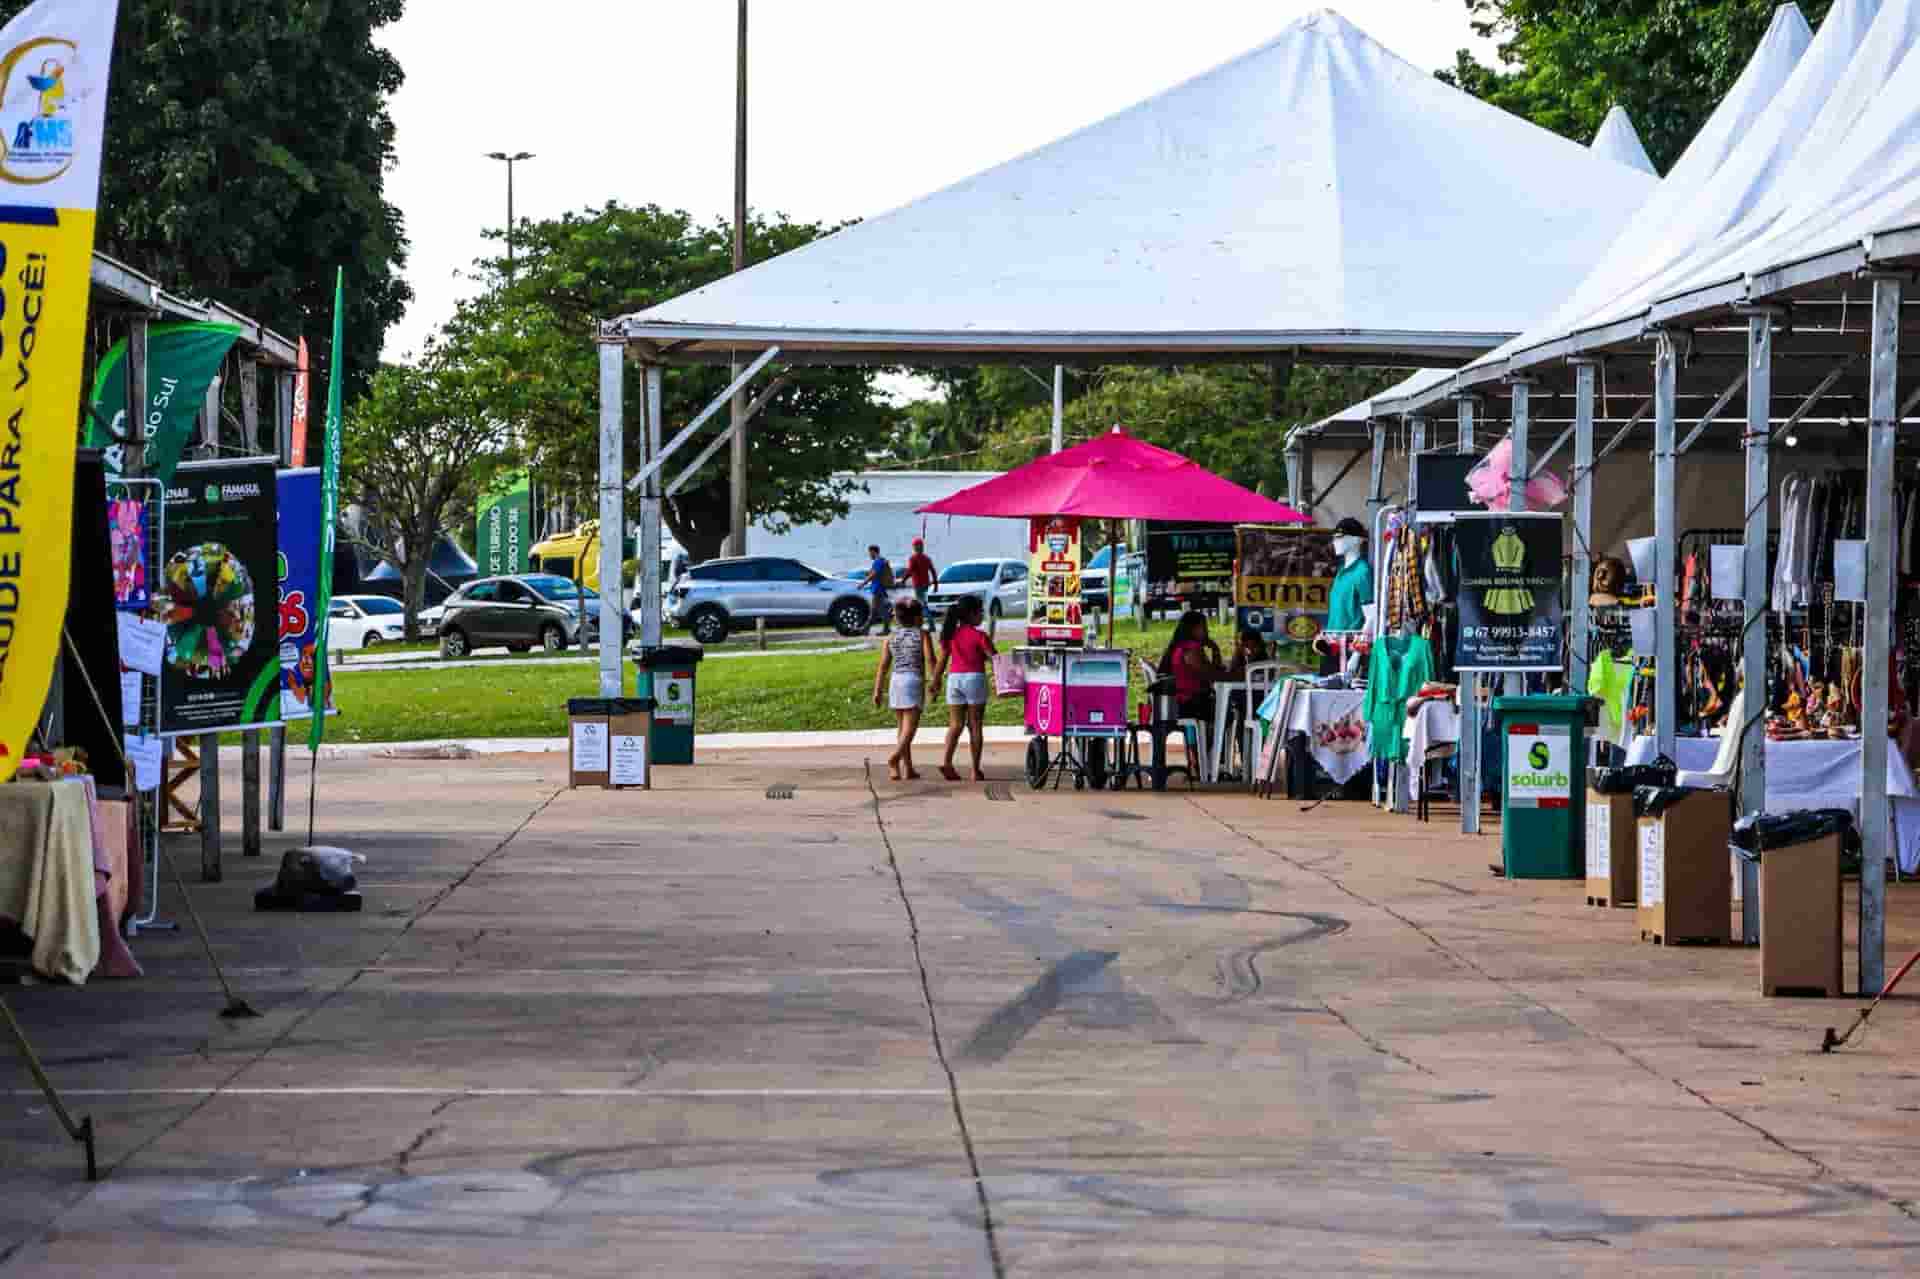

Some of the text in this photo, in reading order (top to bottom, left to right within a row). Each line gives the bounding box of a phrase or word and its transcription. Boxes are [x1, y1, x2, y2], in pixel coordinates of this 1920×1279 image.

[0, 407, 24, 534] PARA
[14, 253, 47, 392] VOCÊ!
[153, 377, 179, 408] Sul
[1511, 771, 1569, 787] solurb
